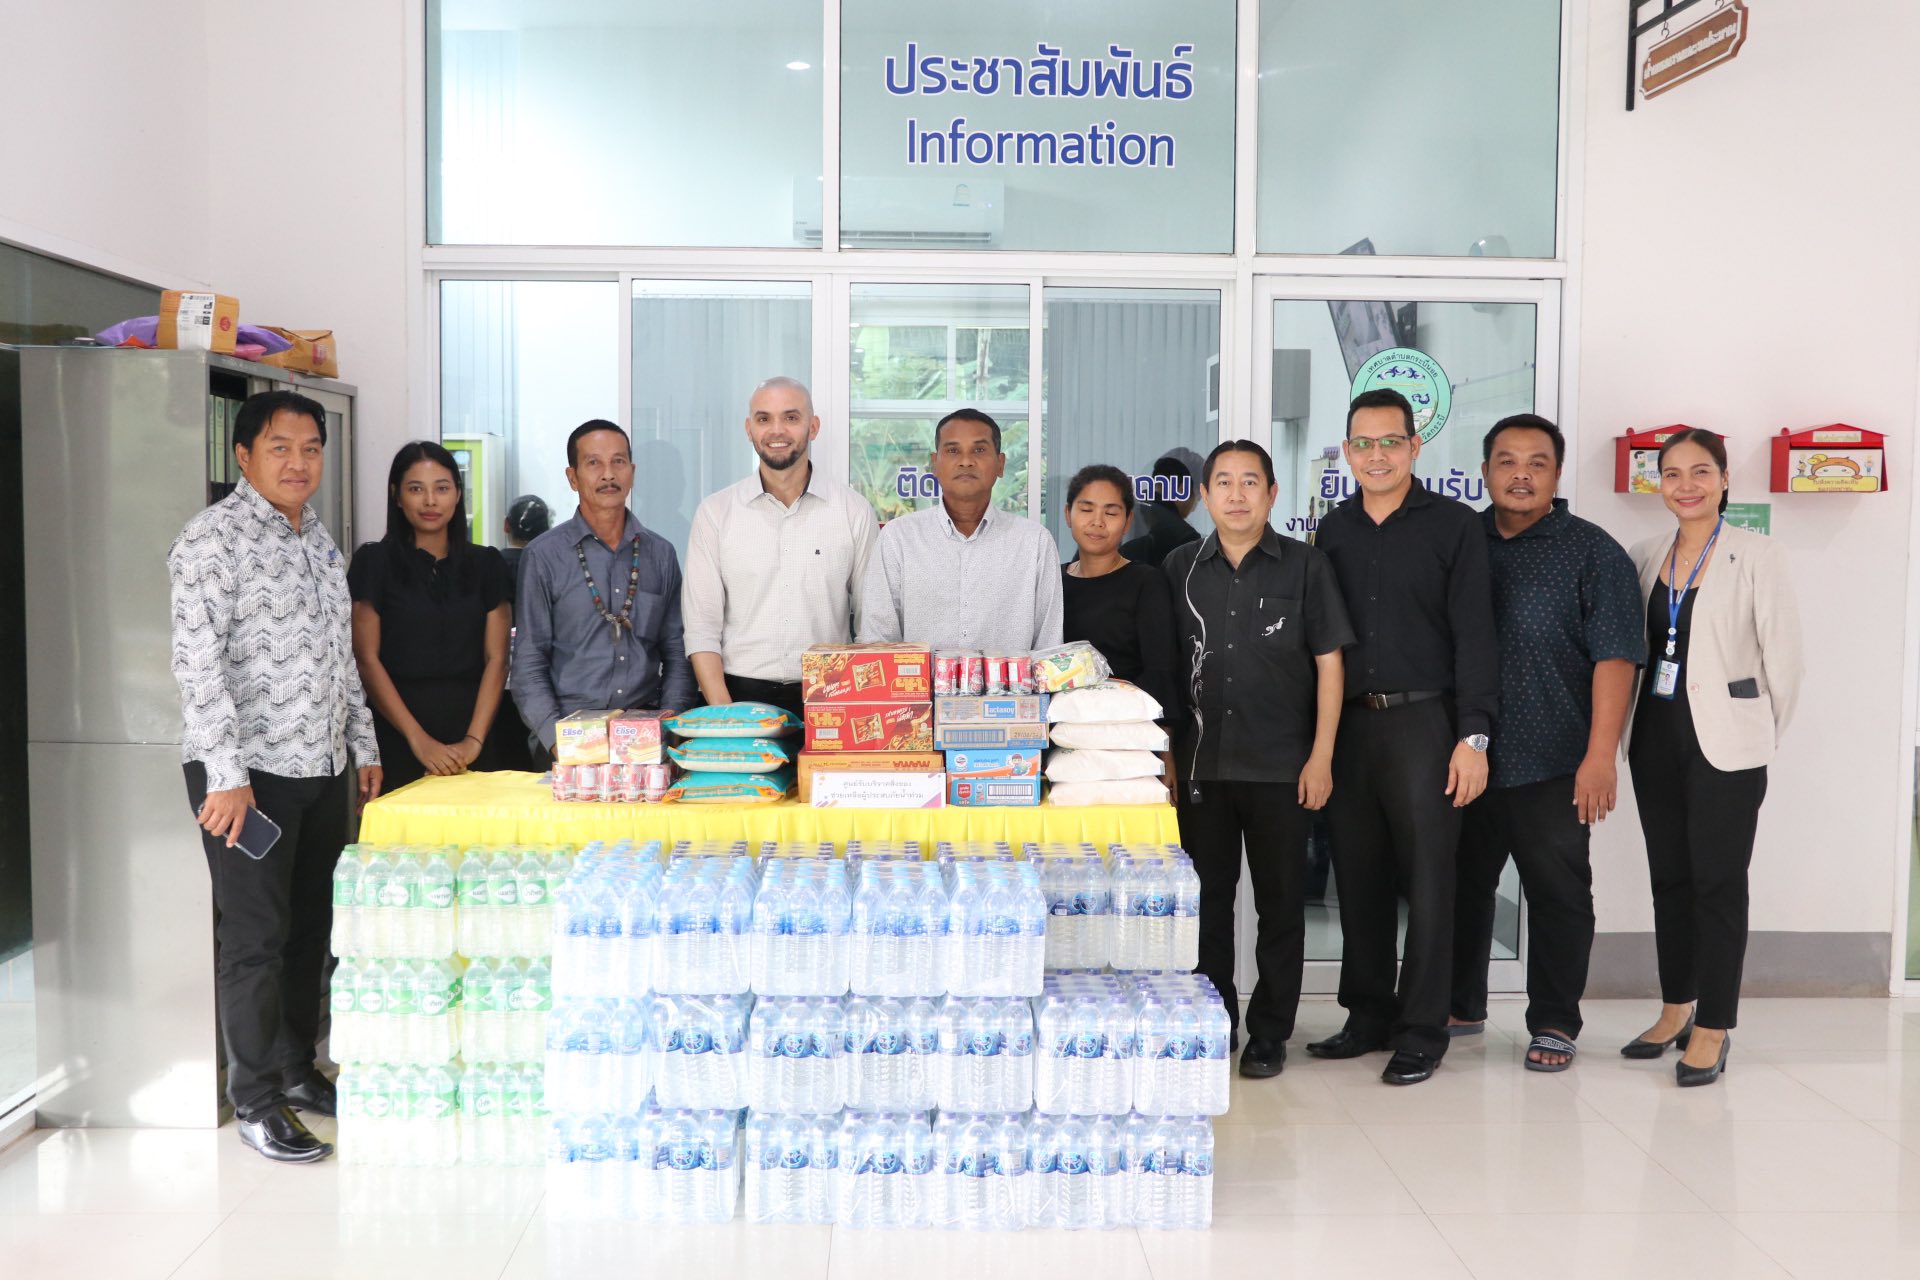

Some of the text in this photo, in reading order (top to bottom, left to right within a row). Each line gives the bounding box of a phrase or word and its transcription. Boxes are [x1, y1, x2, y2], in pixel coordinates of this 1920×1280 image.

[884, 41, 1195, 100] ประชาสัมพันธ์
[906, 118, 1175, 167] Information
[1127, 475, 1191, 502] ถาม
[984, 702, 1015, 717] Lactasoy
[562, 728, 583, 736] Elise
[615, 727, 637, 735] Elise
